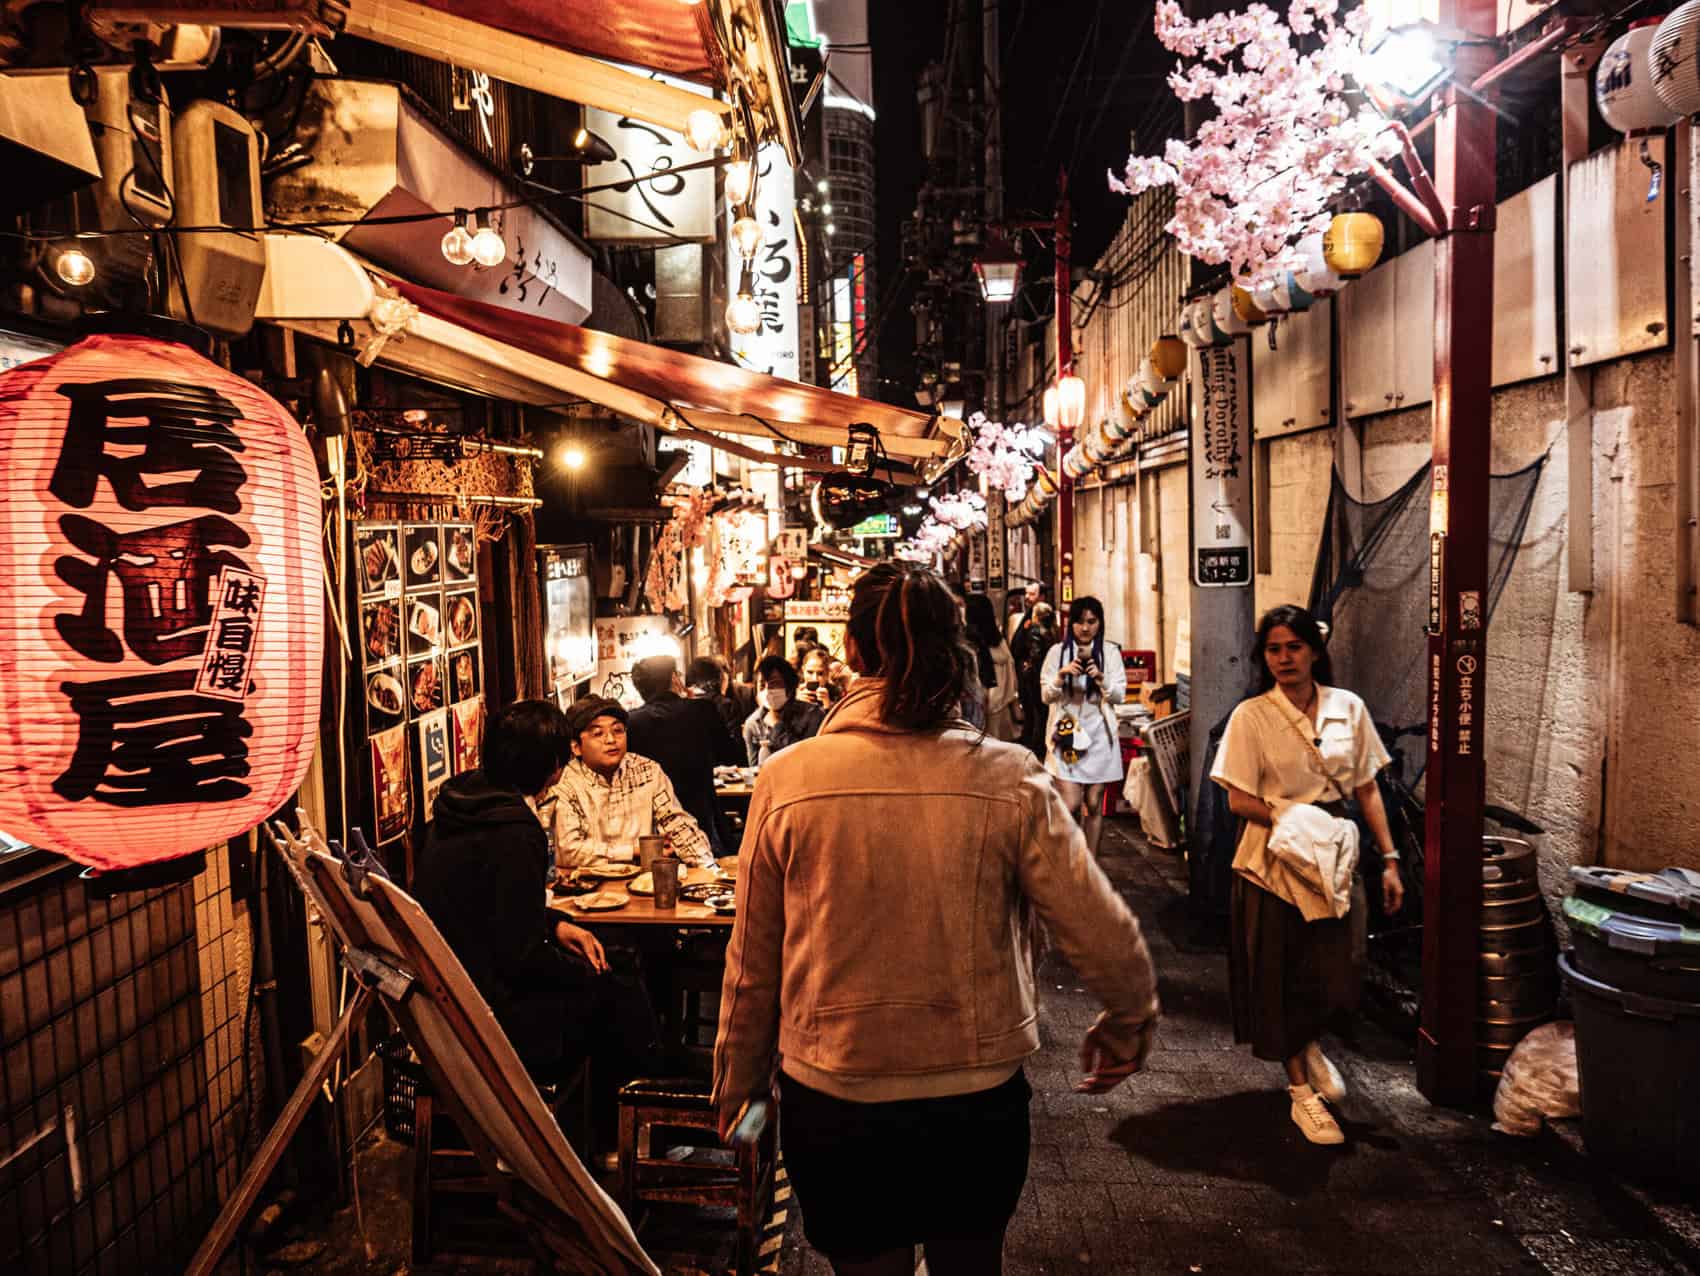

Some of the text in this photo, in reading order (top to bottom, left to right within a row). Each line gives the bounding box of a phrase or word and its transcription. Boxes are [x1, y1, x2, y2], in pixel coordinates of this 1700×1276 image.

[1212, 399, 1231, 464] Dorothy
[50, 380, 253, 804] 居酒屋
[207, 577, 259, 691] 味自慢
